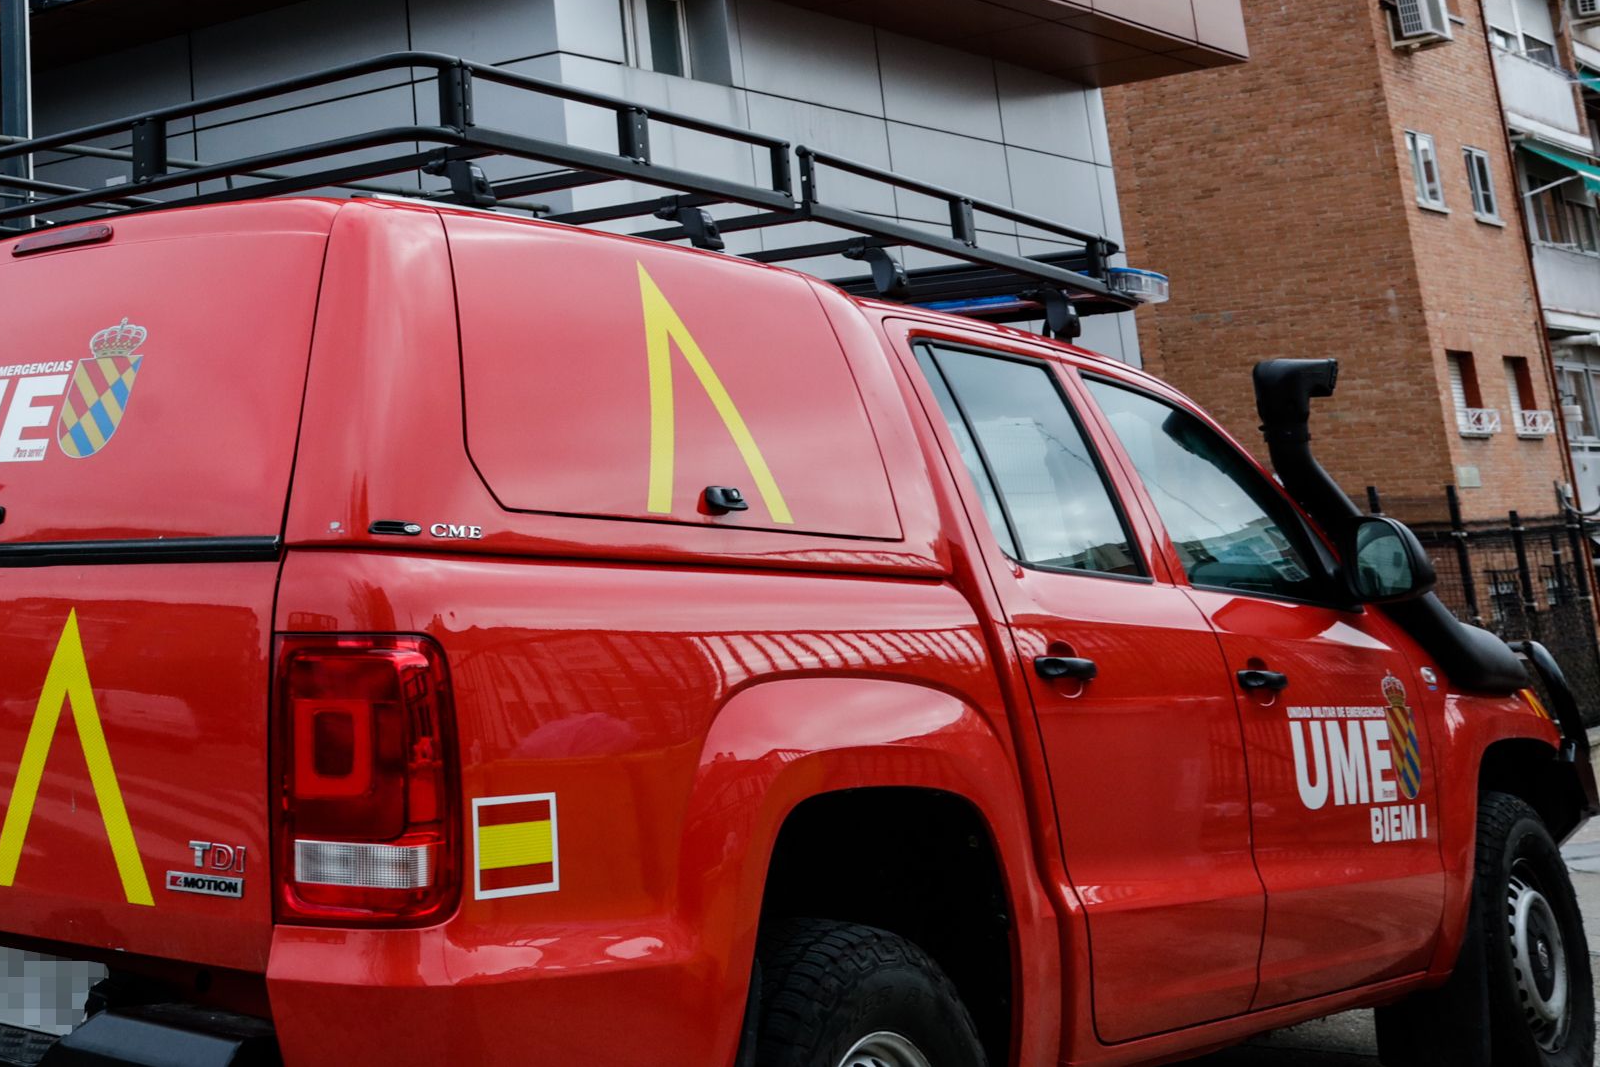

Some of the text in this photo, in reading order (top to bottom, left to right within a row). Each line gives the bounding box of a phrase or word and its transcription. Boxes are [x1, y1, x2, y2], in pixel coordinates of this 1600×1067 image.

[430, 523, 483, 540] CME
[1289, 720, 1398, 811] UME
[1370, 803, 1428, 844] BIEM I
[189, 840, 246, 873] TDI
[172, 875, 239, 894] 4MOTION
